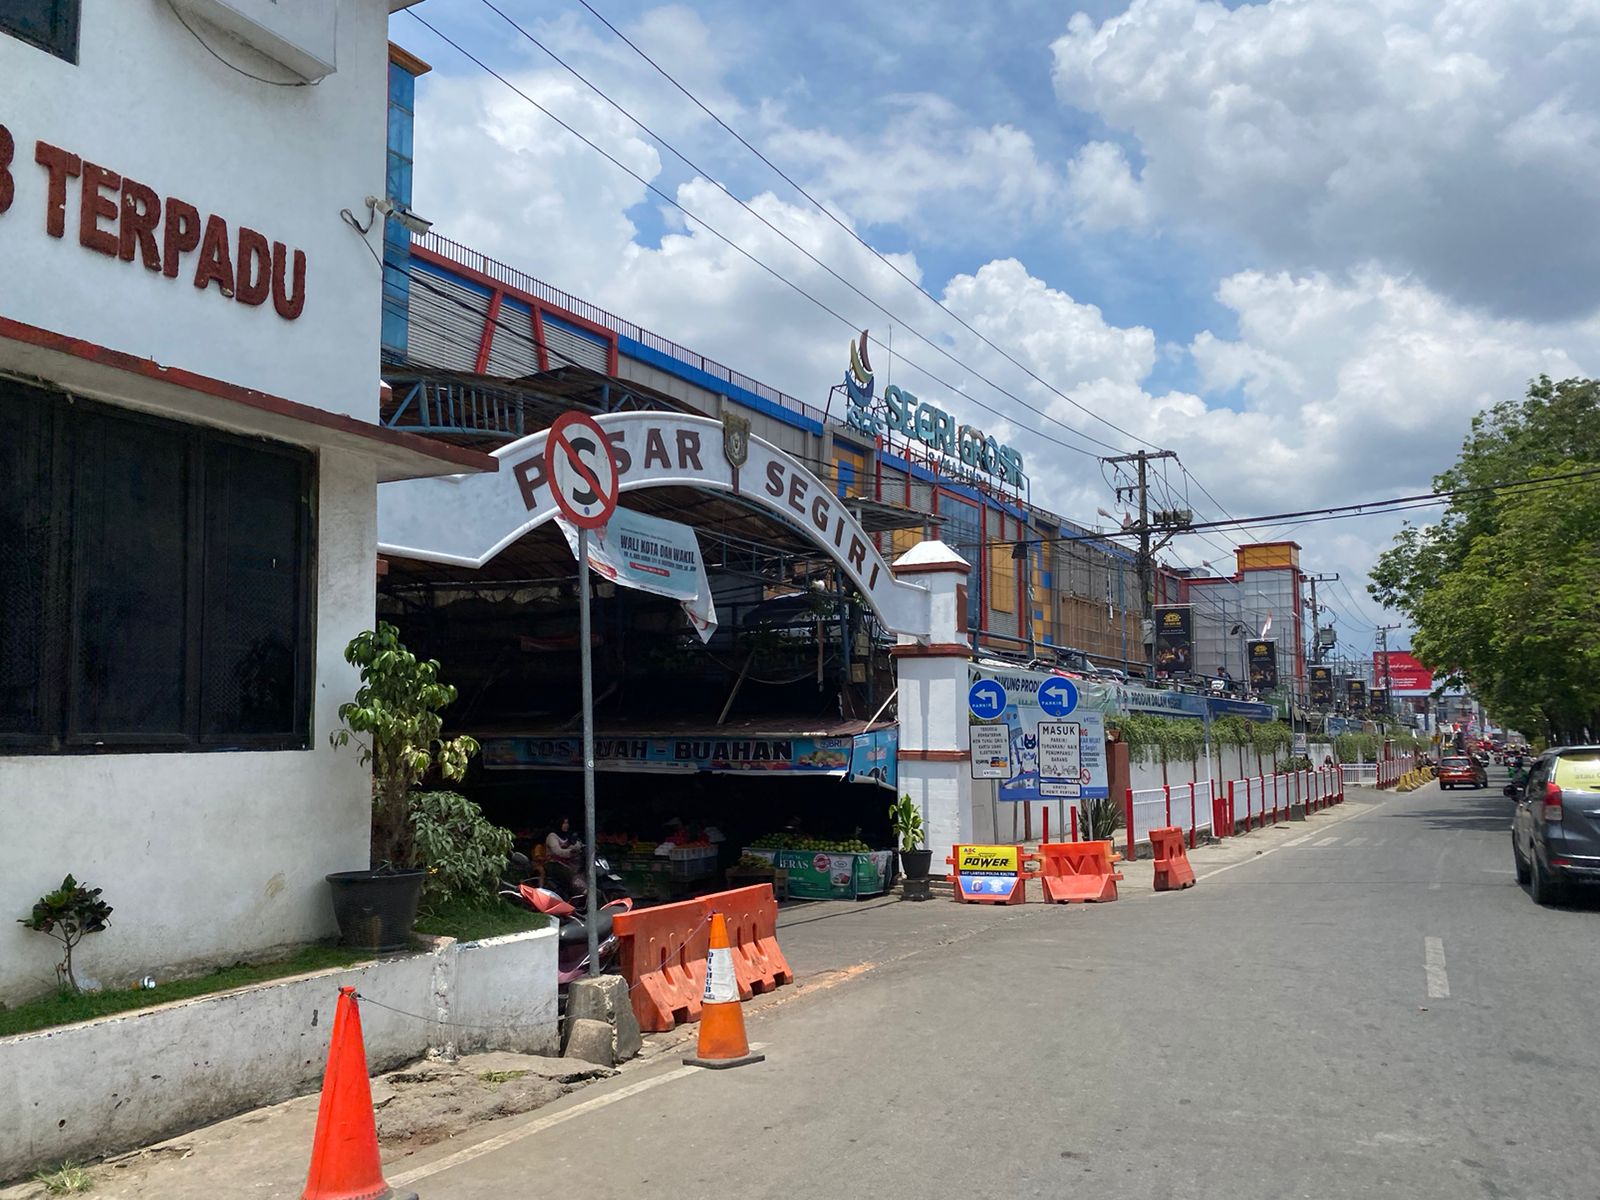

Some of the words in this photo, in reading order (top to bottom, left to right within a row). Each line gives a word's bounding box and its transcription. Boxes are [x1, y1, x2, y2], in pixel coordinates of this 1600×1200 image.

[35, 140, 306, 320] TERPADU
[513, 427, 704, 512] PSAR
[765, 460, 880, 591] SEGIRI
[620, 534, 639, 551] WALI
[640, 538, 659, 557] KOTA
[673, 545, 695, 564] WAKIL
[1042, 726, 1075, 736] MASUK
[673, 740, 796, 761] BUAHAN
[964, 857, 1009, 868] POWER
